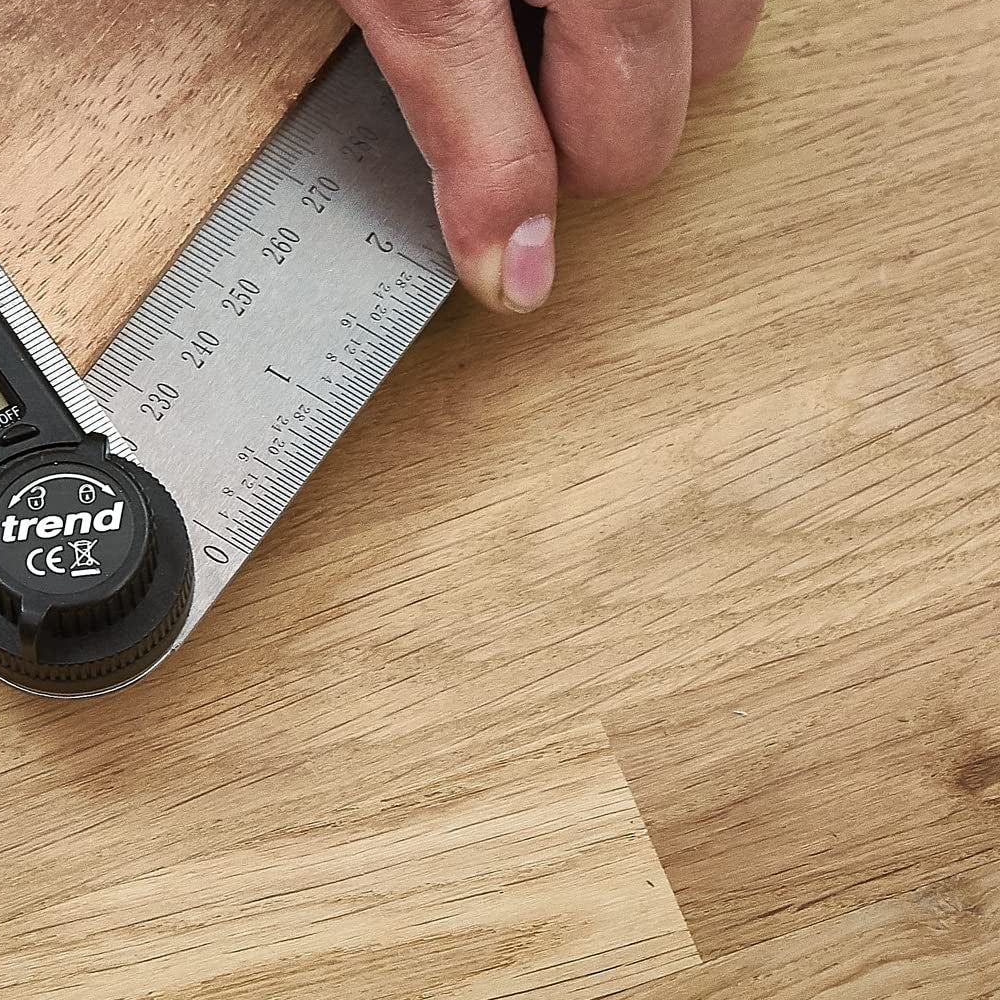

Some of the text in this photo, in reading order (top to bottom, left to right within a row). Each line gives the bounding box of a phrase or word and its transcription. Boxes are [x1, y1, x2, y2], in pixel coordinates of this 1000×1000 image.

[302, 175, 341, 214] 270
[262, 227, 301, 265] 260
[365, 232, 394, 253] 2
[395, 271, 412, 289] 28
[222, 278, 260, 317] 250
[340, 312, 357, 328] 16
[370, 304, 387, 321] 20
[181, 330, 220, 369] 240
[344, 339, 360, 355] 12
[325, 352, 337, 362] 8
[264, 365, 292, 384] 1
[140, 383, 180, 421] 230
[294, 404, 311, 422] 28
[237, 445, 255, 462] 16
[268, 437, 285, 455] 20
[241, 473, 259, 489] 12
[221, 487, 235, 497] 8
[1, 501, 124, 542] trend
[26, 545, 66, 576] CE
[203, 545, 229, 564] 0
